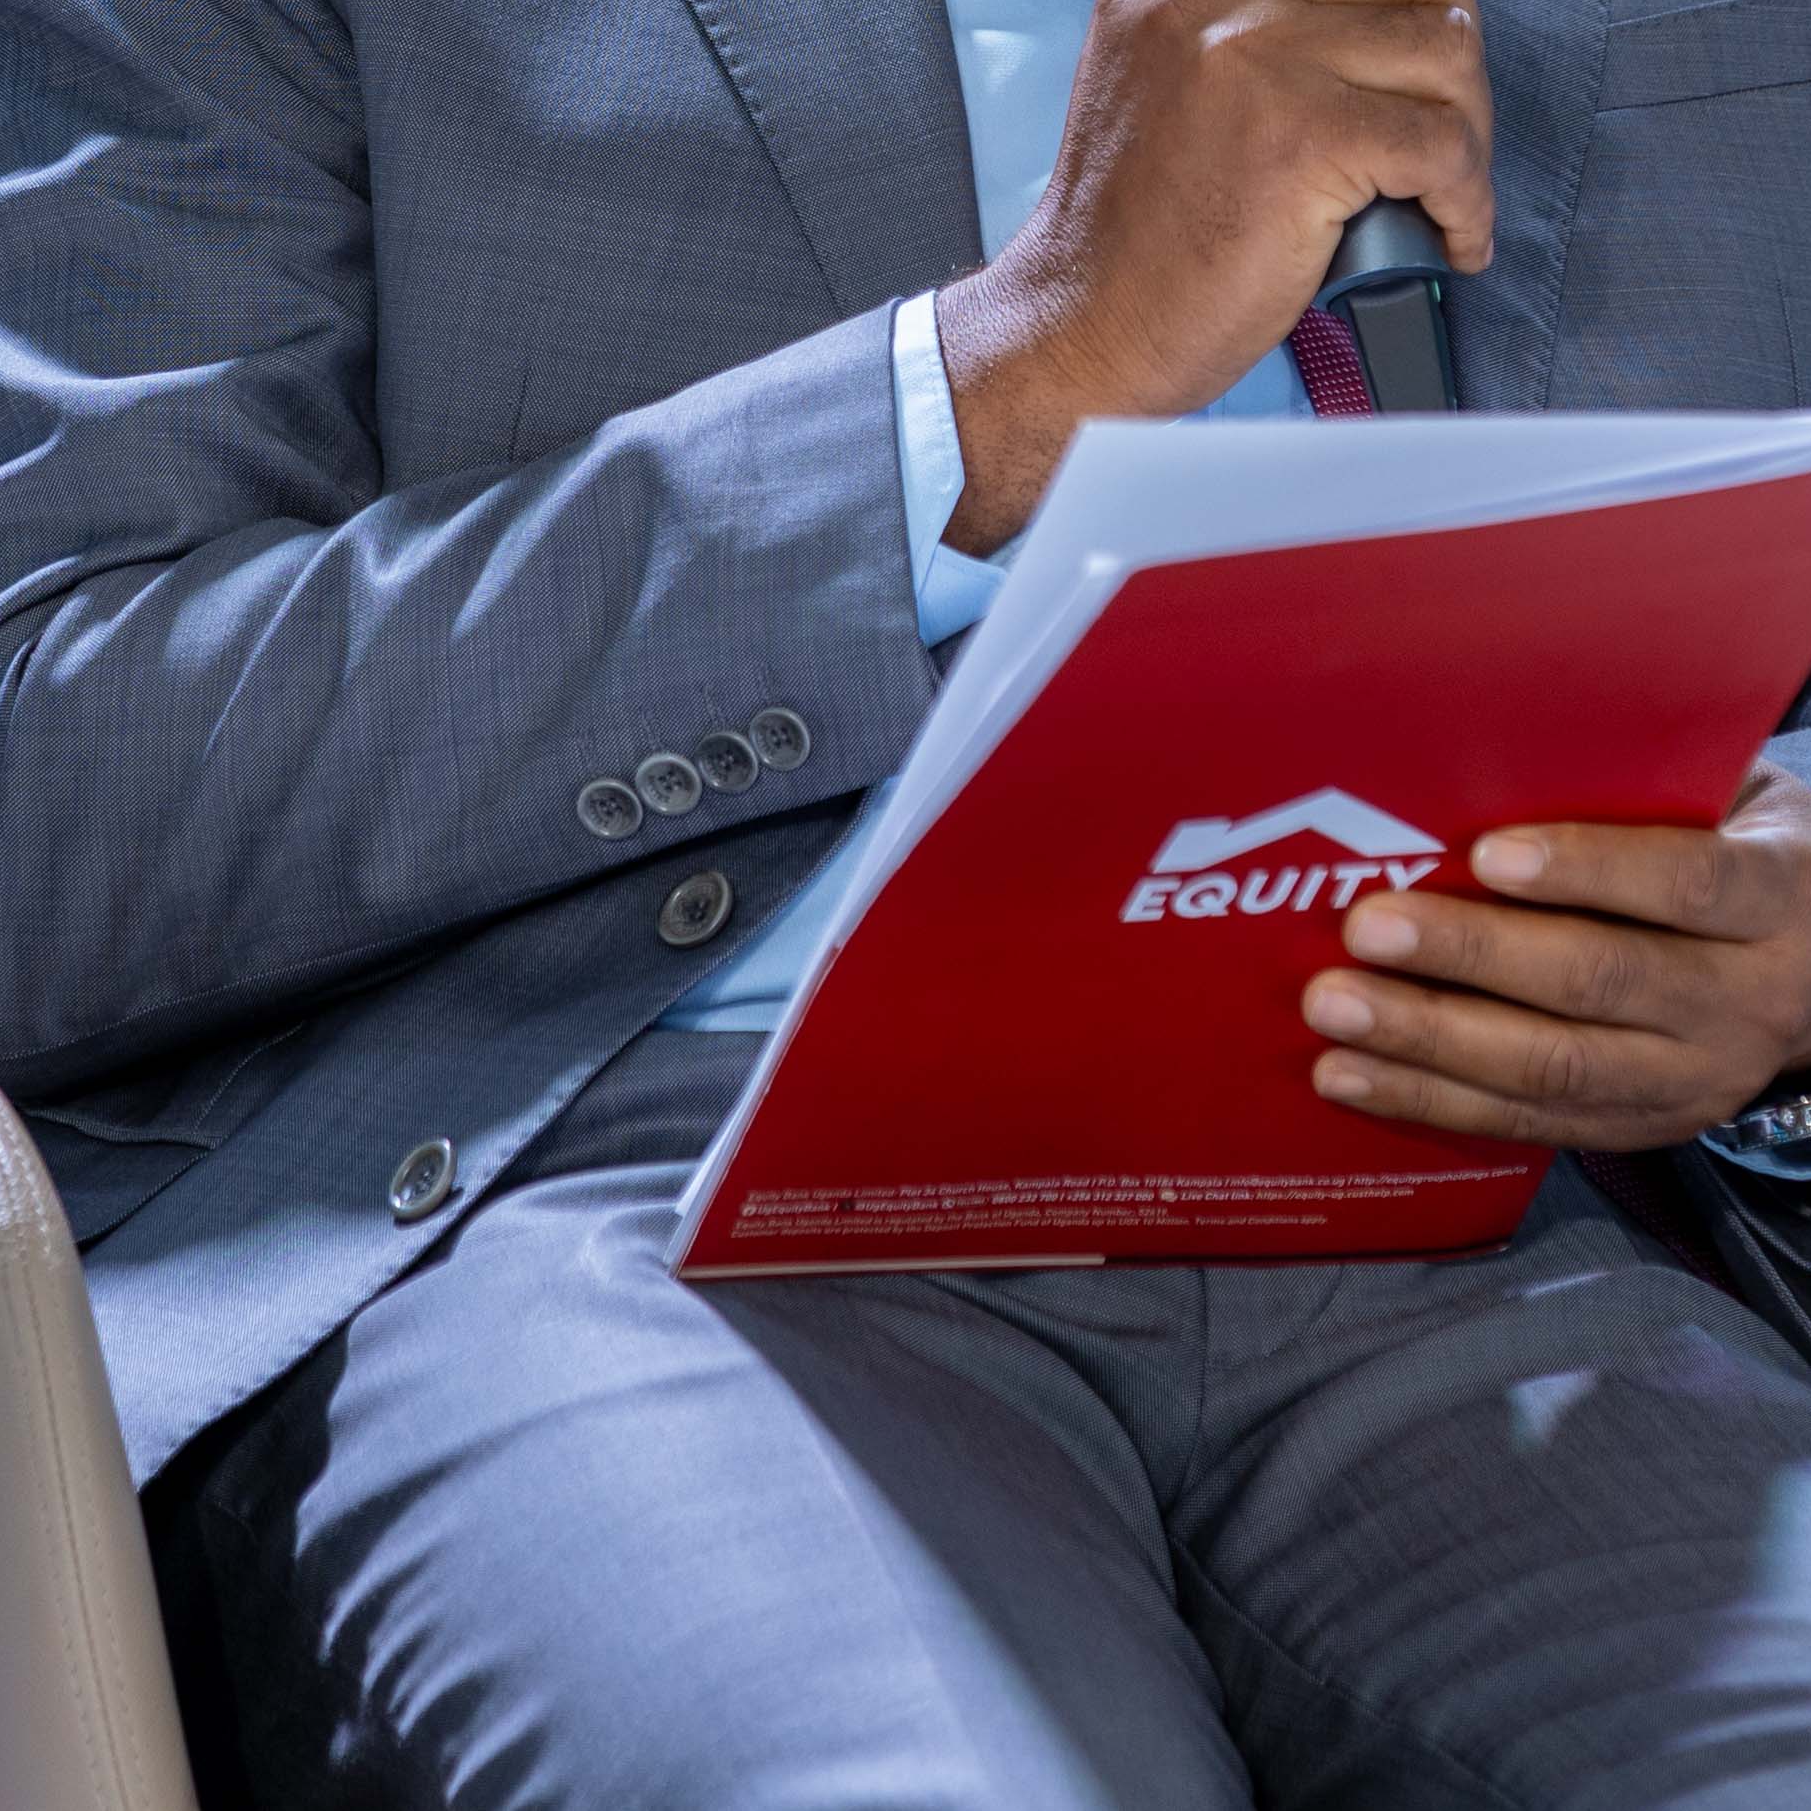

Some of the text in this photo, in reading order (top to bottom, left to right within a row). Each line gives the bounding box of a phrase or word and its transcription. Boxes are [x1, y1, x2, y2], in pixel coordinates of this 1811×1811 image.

[1119, 857, 1441, 923] EQUITY
[812, 1188, 852, 1200] Uganda
[1014, 1178, 1061, 1191] Kampala
[1062, 1177, 1090, 1188] Road
[1176, 1177, 1223, 1190] Kampala
[1180, 1191, 1204, 1201] Live
[1205, 1191, 1230, 1201] Chat
